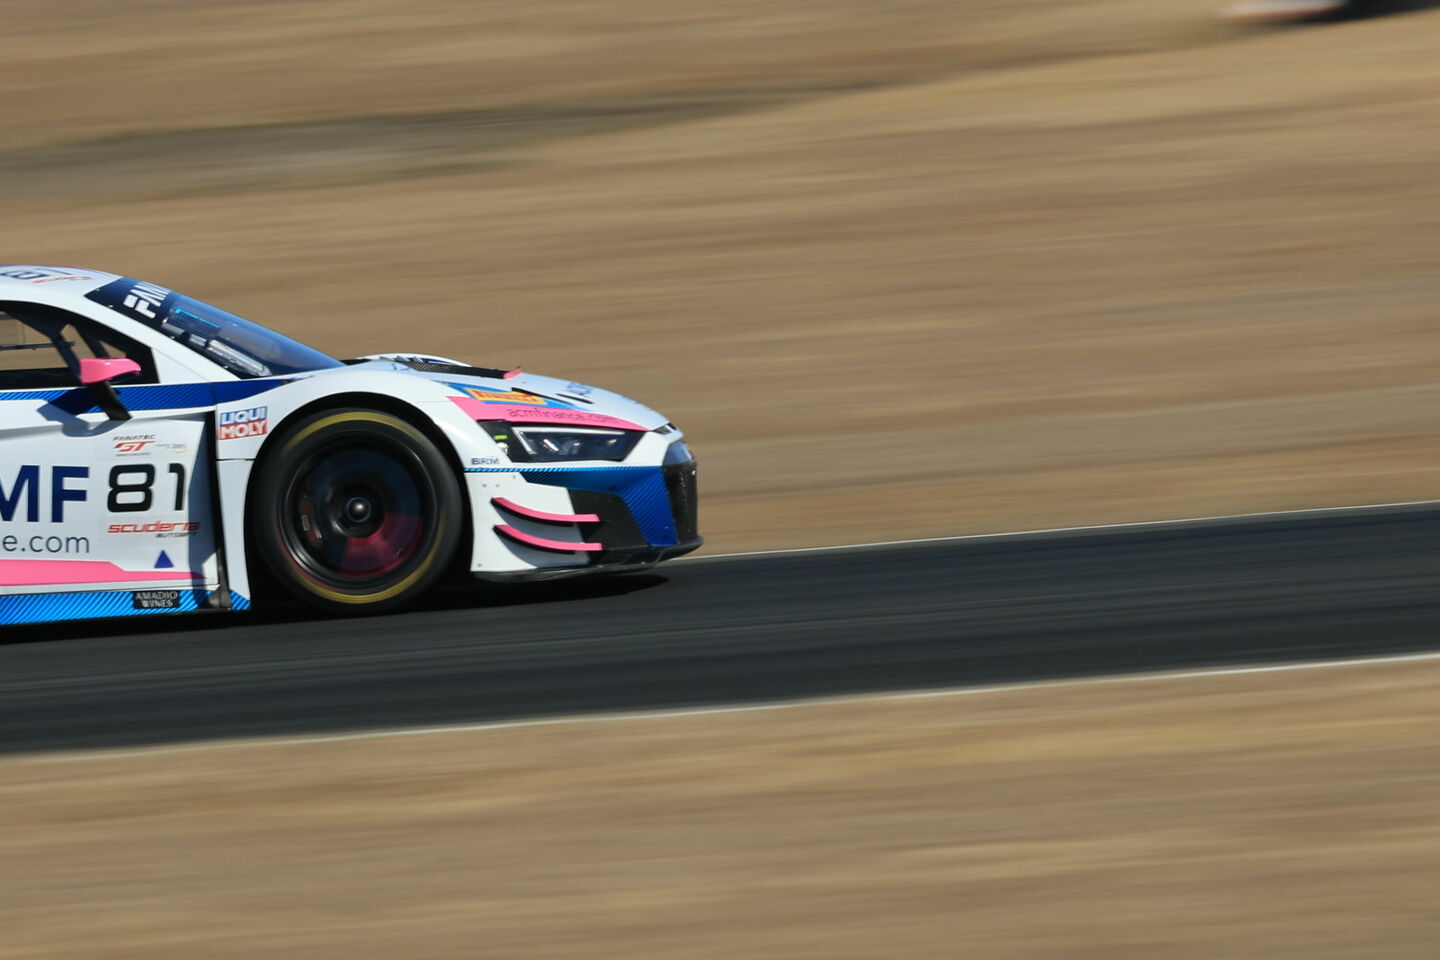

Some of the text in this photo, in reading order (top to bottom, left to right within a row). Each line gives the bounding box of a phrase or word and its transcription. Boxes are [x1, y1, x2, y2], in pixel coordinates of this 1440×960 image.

[221, 407, 266, 425] LIQUI
[220, 421, 266, 439] MOLY
[107, 463, 185, 513] 81
[135, 591, 178, 600] AMADIO
[141, 600, 174, 608] WINES
